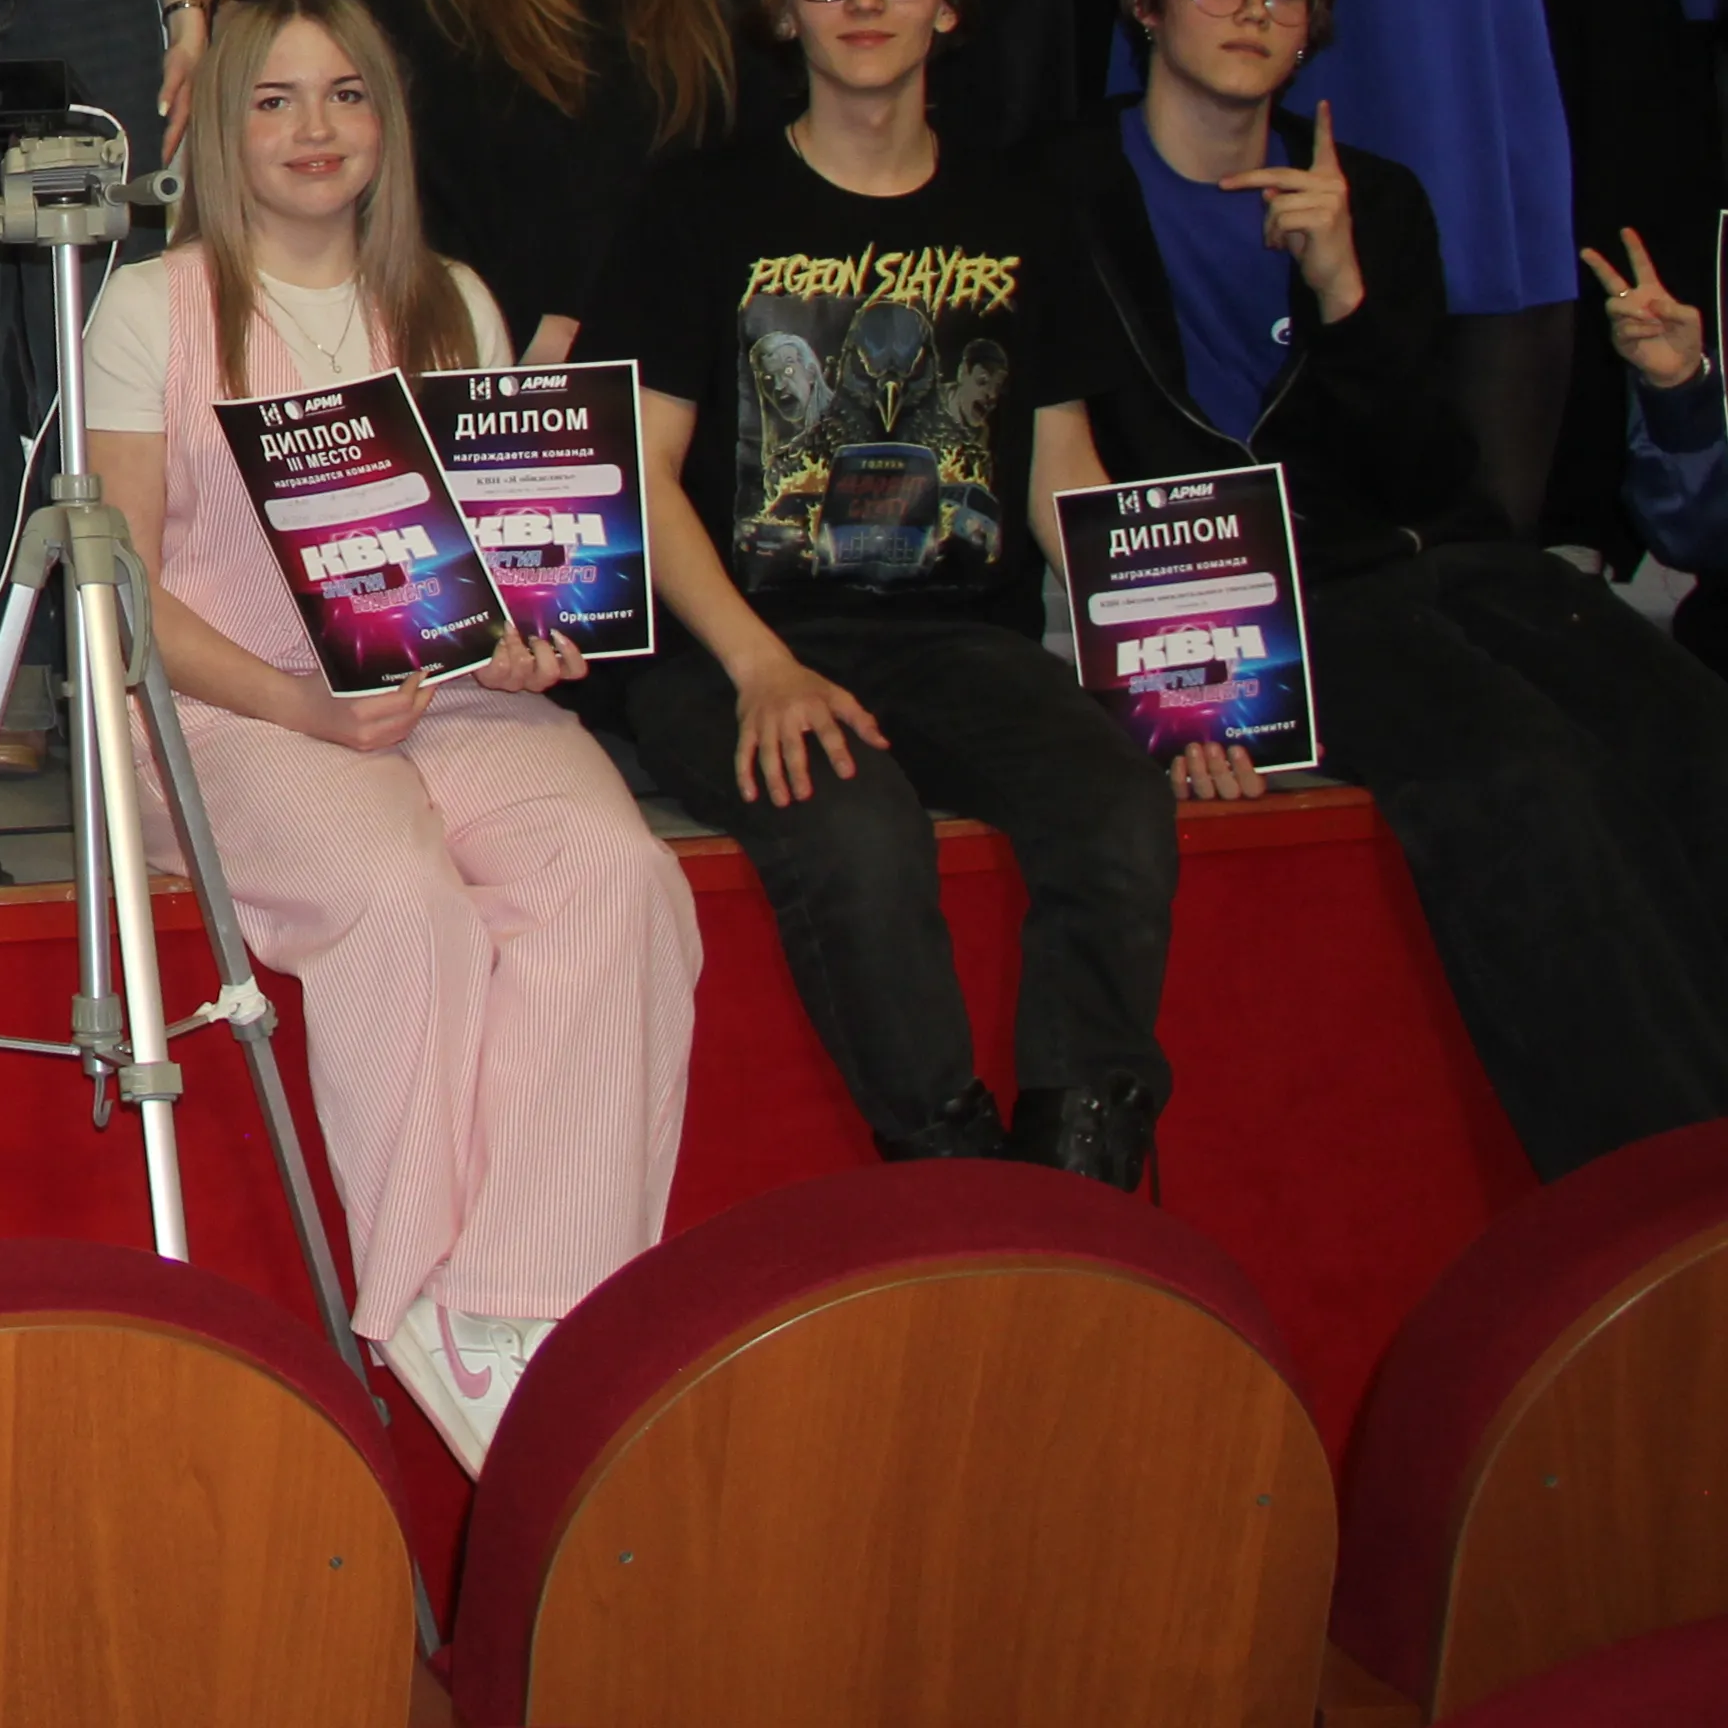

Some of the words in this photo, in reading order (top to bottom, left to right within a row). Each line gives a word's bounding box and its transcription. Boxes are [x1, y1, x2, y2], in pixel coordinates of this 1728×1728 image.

[738, 241, 875, 311] PIGEON
[862, 246, 1021, 320] SLAYERS
[521, 374, 568, 389] АРМИ
[305, 393, 342, 412] АРМИ
[455, 407, 588, 440] ДИПЛОМ
[260, 416, 375, 462] ДИПЛОМ
[286, 457, 303, 472] III
[305, 445, 362, 468] МЕСТО
[453, 450, 538, 463] награждается
[542, 447, 594, 458] команда
[273, 470, 344, 488] награждается
[345, 459, 393, 477] команда
[1169, 482, 1215, 500] АРМИ
[466, 513, 608, 547] КВН
[1109, 515, 1239, 558] ДИПЛОМ
[300, 525, 438, 582] КВН
[1110, 564, 1193, 581] награждается
[1196, 557, 1248, 570] команда
[420, 611, 490, 640] Оргкомитет
[559, 609, 633, 624] Оргкомитет
[1117, 625, 1267, 676] КВН
